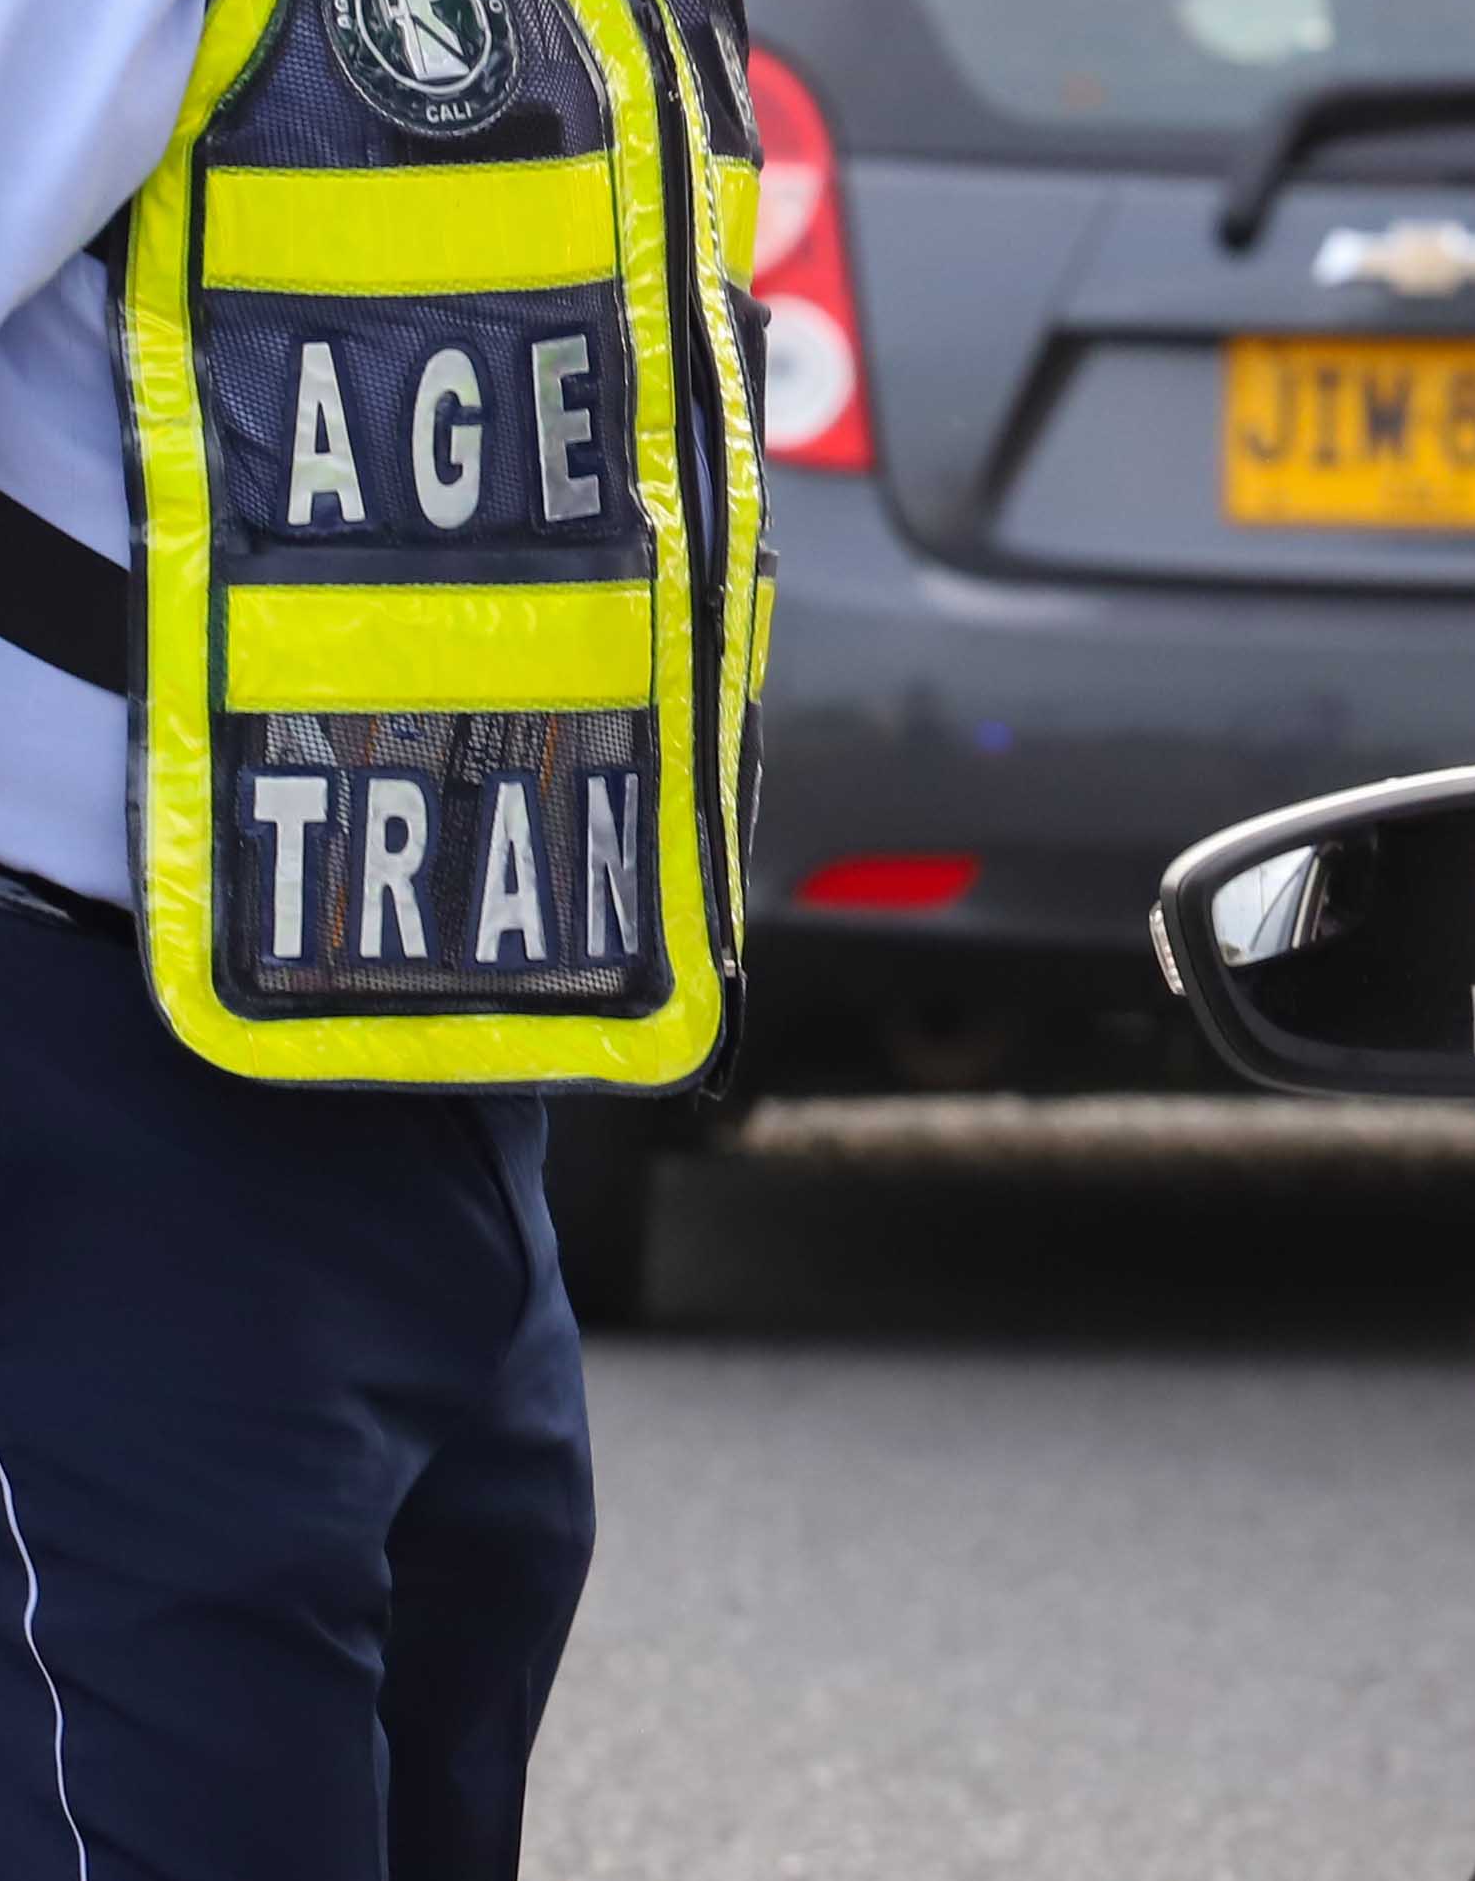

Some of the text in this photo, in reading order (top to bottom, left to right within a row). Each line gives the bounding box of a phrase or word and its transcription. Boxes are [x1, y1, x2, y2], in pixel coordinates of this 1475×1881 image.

[426, 100, 473, 124] CALI
[287, 334, 600, 530] AGE
[253, 772, 638, 962] TRAN
